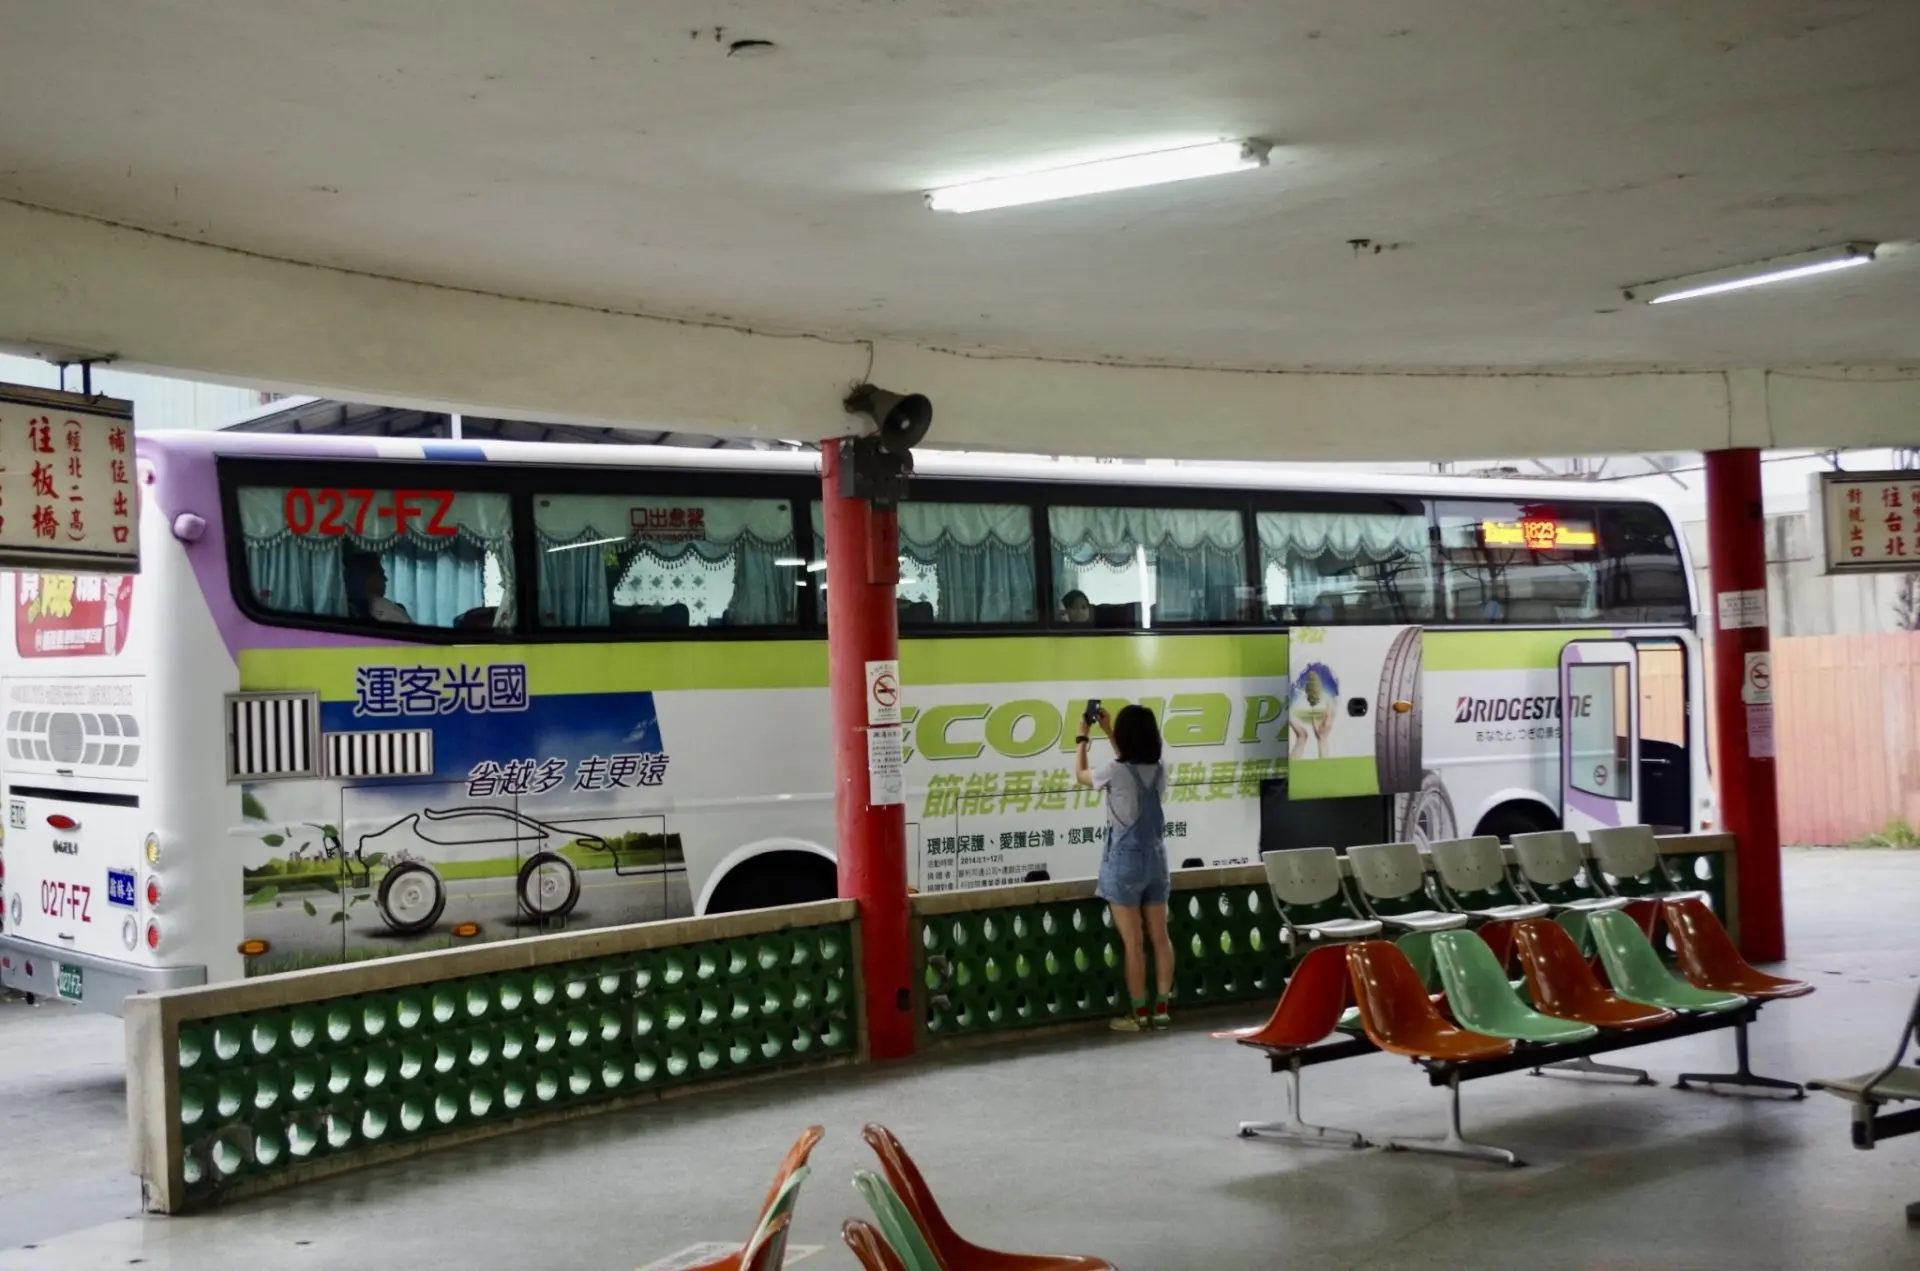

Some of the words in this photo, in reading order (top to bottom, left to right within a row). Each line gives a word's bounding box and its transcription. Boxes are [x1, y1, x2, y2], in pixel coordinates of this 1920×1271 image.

[28, 415, 60, 540] 往板橋
[108, 426, 129, 543] 補位出口
[285, 487, 459, 537] 027-FZ
[1524, 521, 1555, 540] 1823
[1882, 486, 1906, 556] 往台北
[468, 758, 567, 798] 省越多
[574, 751, 670, 793] 走更遠
[11, 805, 25, 824] ETC
[41, 879, 92, 922] 027-FZ
